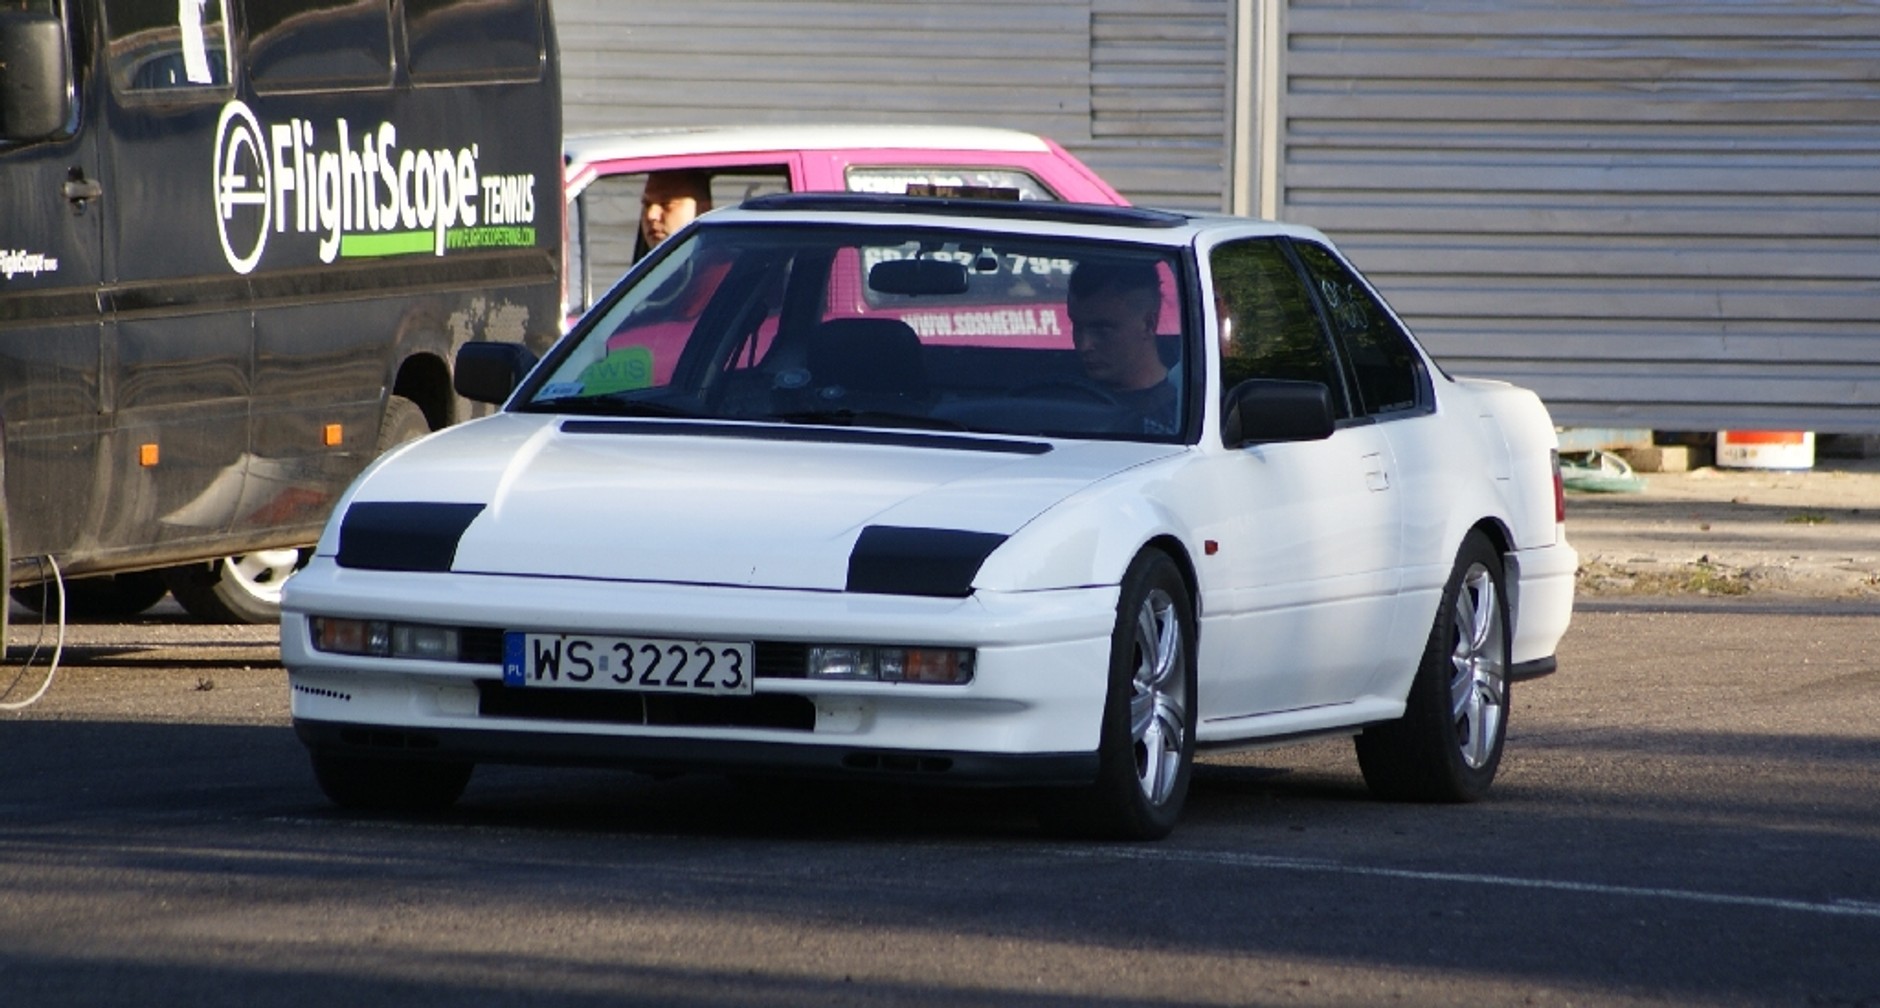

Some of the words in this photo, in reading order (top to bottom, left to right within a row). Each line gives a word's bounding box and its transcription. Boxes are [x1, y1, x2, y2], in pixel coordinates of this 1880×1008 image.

[271, 117, 479, 263] FlightScope
[481, 174, 536, 226] TENNIS
[1005, 253, 1073, 274] 794
[900, 309, 1062, 337] WWW.SOSMEDIA.PL
[507, 664, 523, 676] PL
[533, 638, 594, 682] WS
[611, 642, 744, 690] 32223
